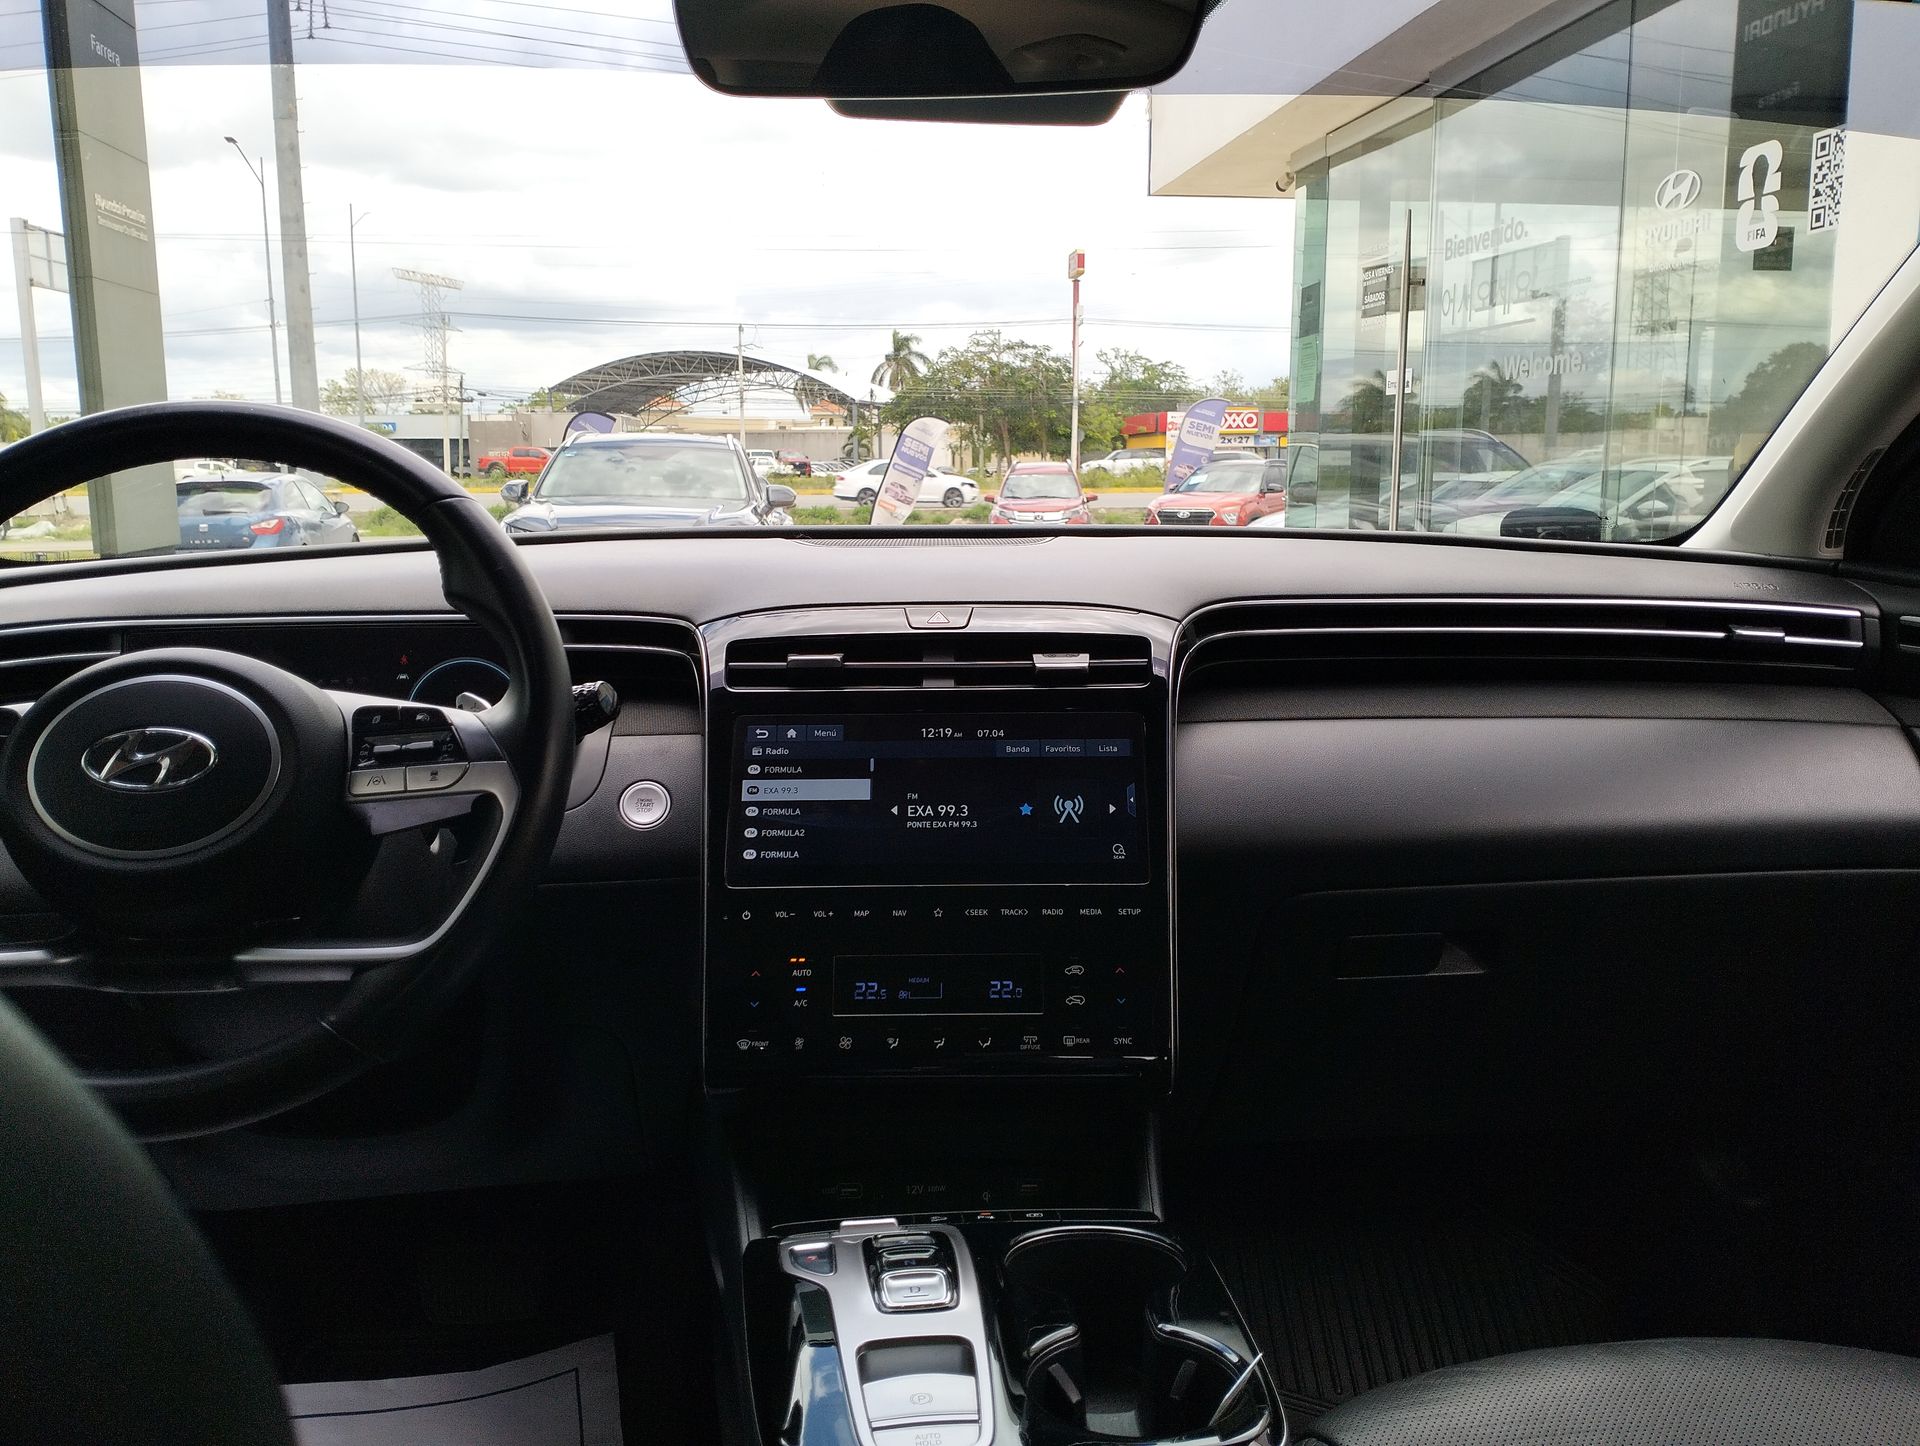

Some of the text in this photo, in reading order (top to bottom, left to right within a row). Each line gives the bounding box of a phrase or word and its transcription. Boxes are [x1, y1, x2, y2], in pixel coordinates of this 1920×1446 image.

[90, 33, 121, 67] Farrera
[1747, 227, 1766, 242] FIFA
[1444, 217, 1529, 261] Bienvenido.
[1188, 420, 1216, 435] SEMI
[814, 729, 837, 737] Menú
[921, 727, 953, 738] 12:19
[977, 729, 1005, 738] 07.04
[766, 747, 789, 755] Radio
[1006, 745, 1030, 753] Banda
[1045, 745, 1081, 753] Favoritos
[1098, 744, 1118, 752] Lista
[764, 766, 802, 774] FORMULA
[907, 804, 969, 817] EXA 99.3
[907, 821, 931, 829] PONTE
[961, 820, 978, 828] 99.3
[761, 829, 806, 837] FORMULA2
[760, 850, 800, 858] FORMULA
[1042, 908, 1064, 916] RADIO
[1080, 908, 1102, 916] MEDIA
[1117, 908, 1141, 916] SETUP
[792, 969, 812, 977] AUTO
[793, 999, 808, 1008] A/C
[1113, 1037, 1133, 1045] SYNC
[914, 1432, 941, 1441] AUTO
